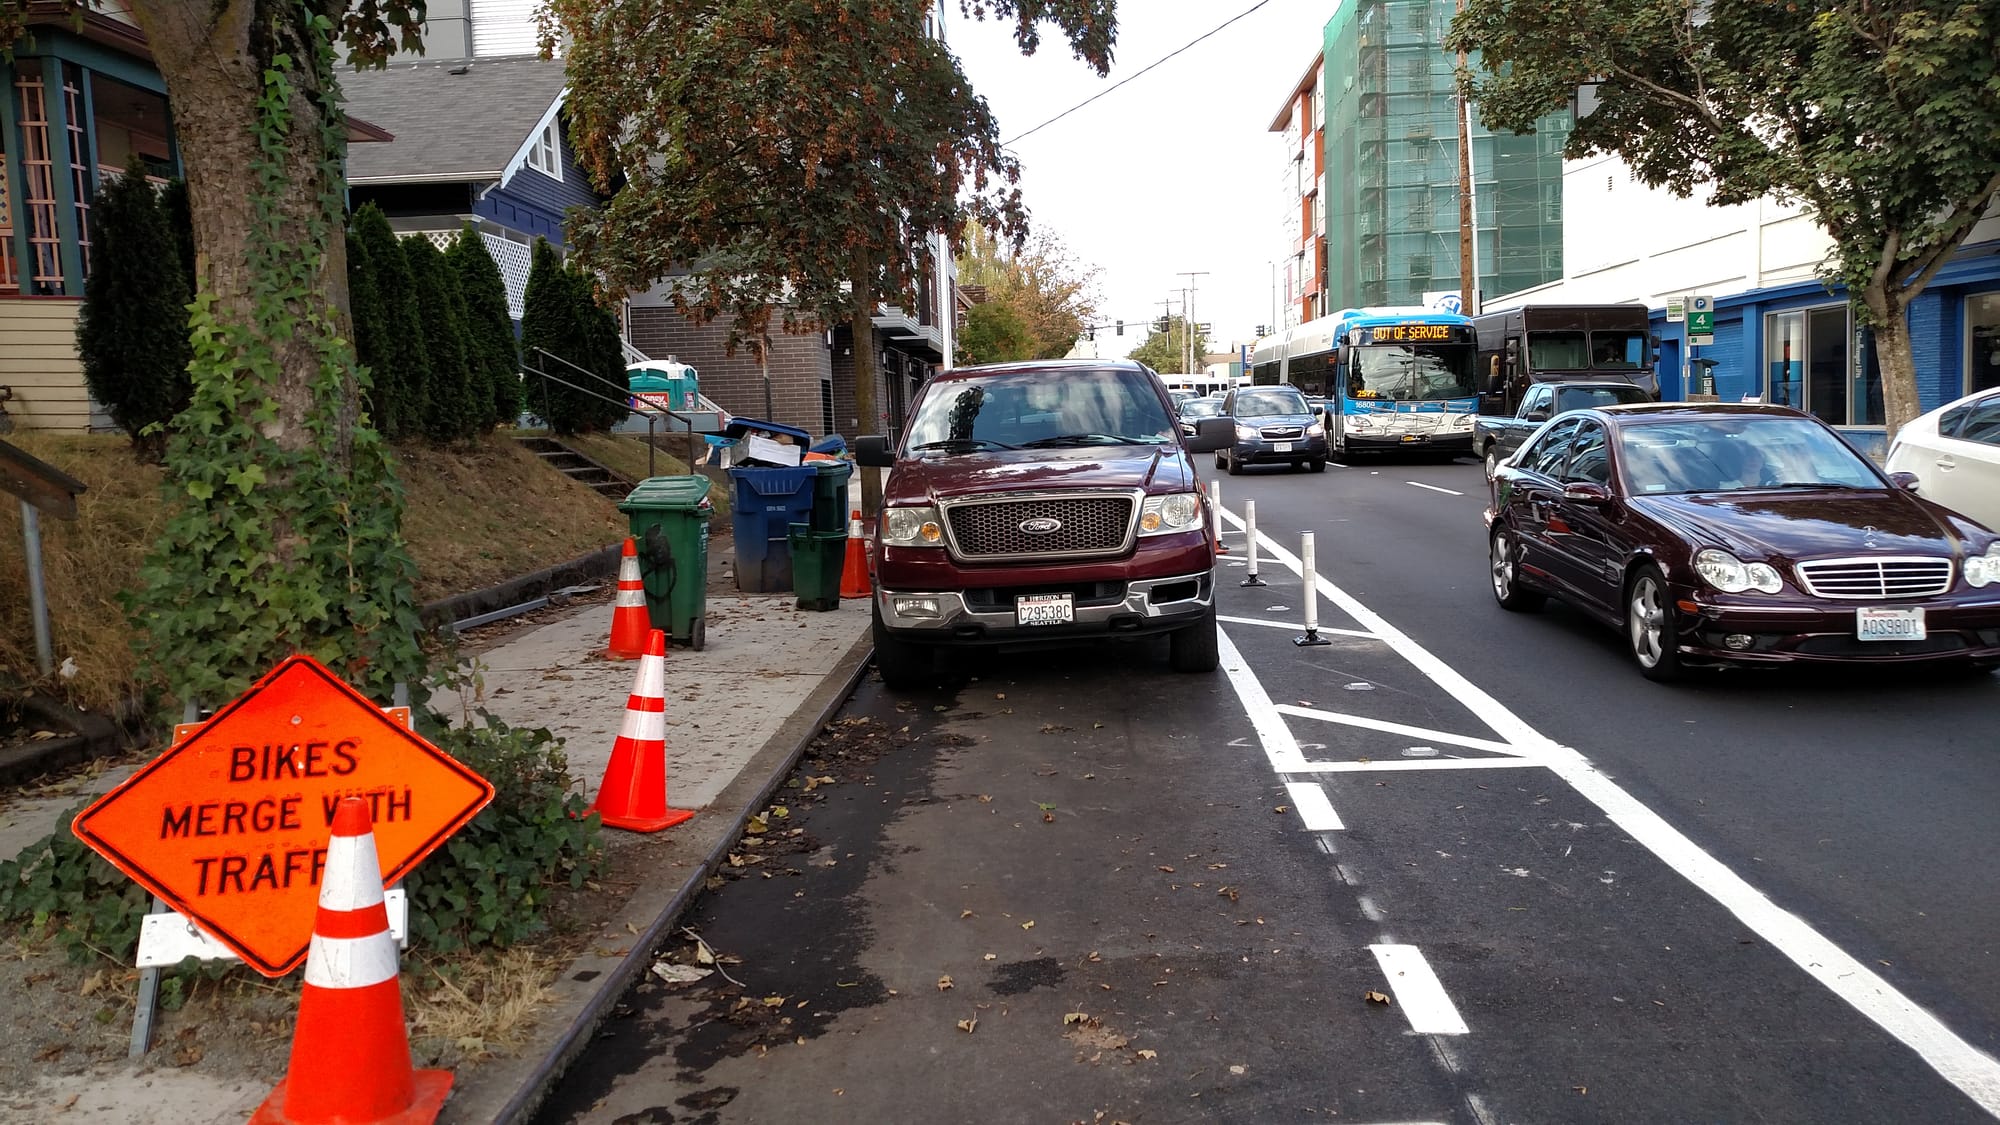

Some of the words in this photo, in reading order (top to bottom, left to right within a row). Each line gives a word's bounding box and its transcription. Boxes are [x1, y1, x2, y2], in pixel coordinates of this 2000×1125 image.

[1696, 314, 1706, 325] 4
[1373, 327, 1391, 340] OUT
[1394, 327, 1406, 340] OF
[1409, 326, 1449, 339] SERVICE
[1026, 519, 1053, 532] Ford
[1020, 604, 1071, 621] C29538C
[230, 740, 358, 783] BIKES
[160, 797, 303, 839] MERGE
[322, 789, 412, 826] WTH
[191, 848, 328, 896] TRAFF
